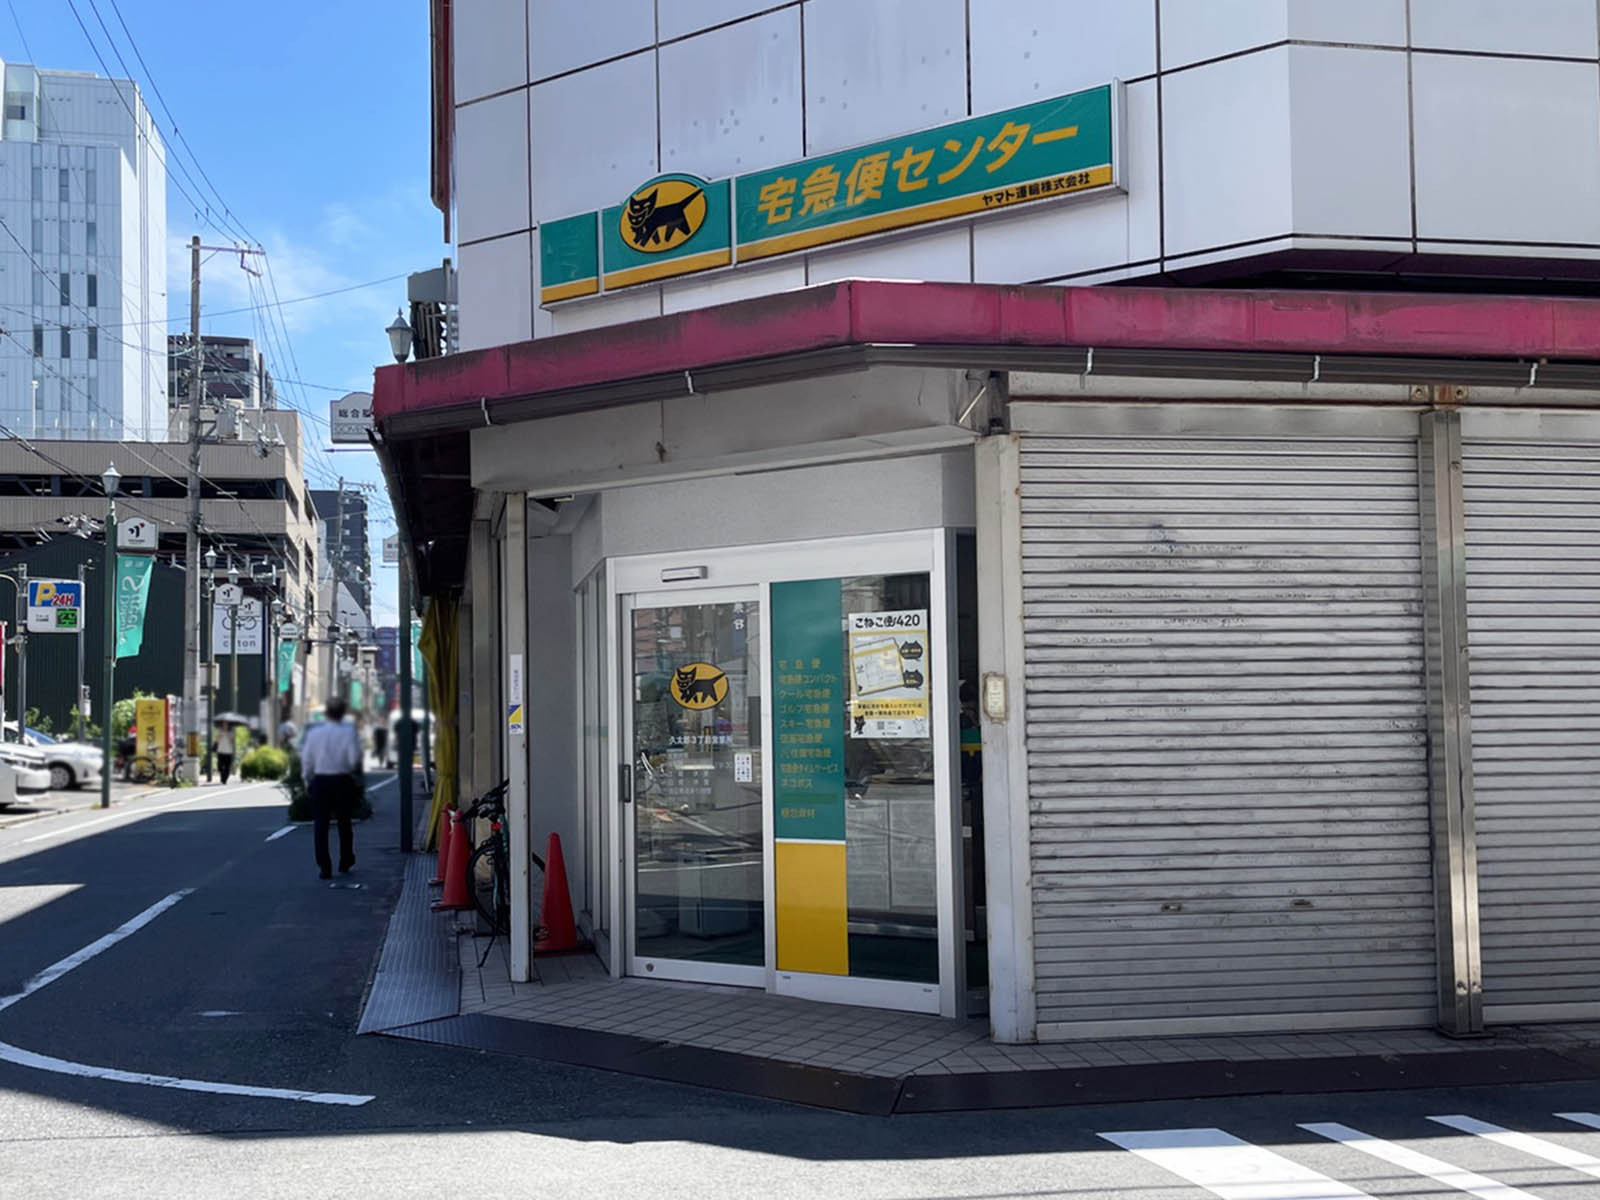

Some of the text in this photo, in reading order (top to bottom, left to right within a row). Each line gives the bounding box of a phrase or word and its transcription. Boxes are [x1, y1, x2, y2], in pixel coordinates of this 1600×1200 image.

[756, 121, 1079, 224] 宅急便センター
[981, 171, 1091, 207] ヤマト運輸株式会社
[34, 583, 75, 607] P 24H
[855, 614, 921, 629] こねこ便420
[222, 639, 257, 648] cton
